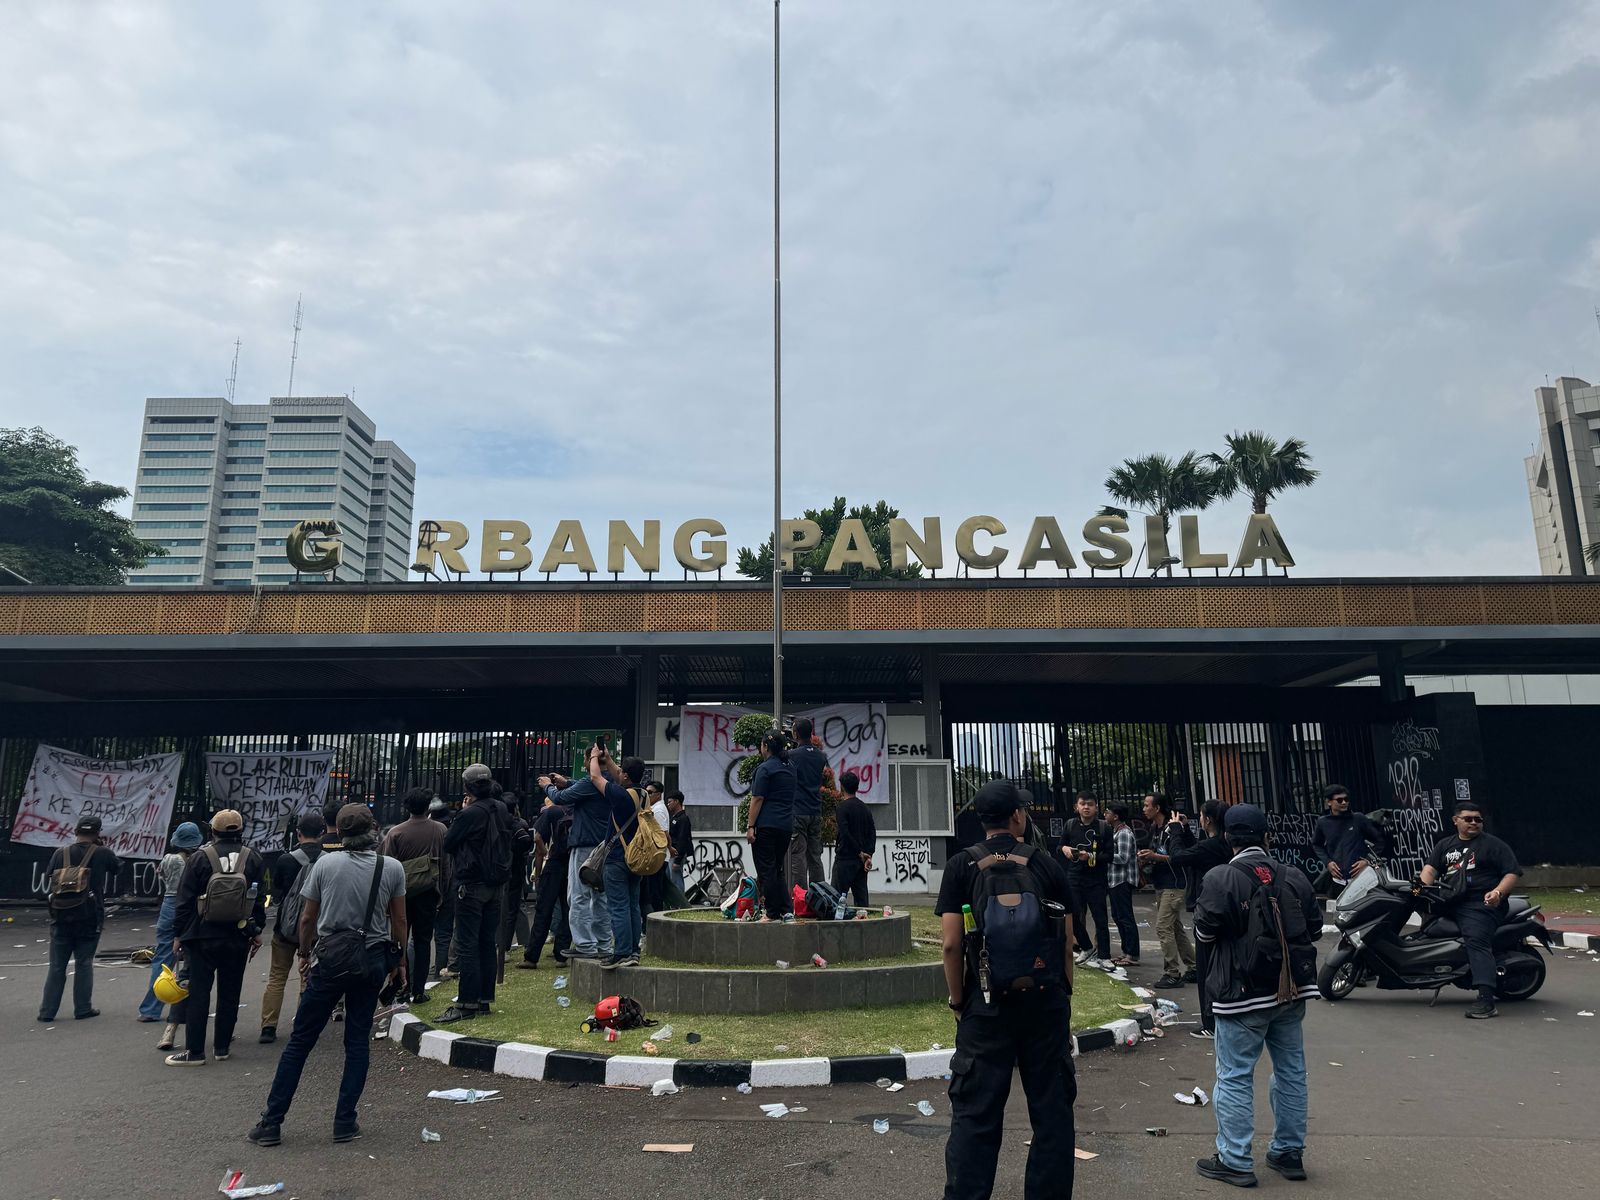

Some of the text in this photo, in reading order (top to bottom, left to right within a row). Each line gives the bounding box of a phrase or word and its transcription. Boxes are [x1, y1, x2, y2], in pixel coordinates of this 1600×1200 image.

[780, 513, 1296, 573] PANCASILA
[211, 758, 277, 777] TOLAK
[48, 794, 73, 815] KE
[895, 838, 929, 850] REZIM
[1393, 831, 1435, 859] JALAN
